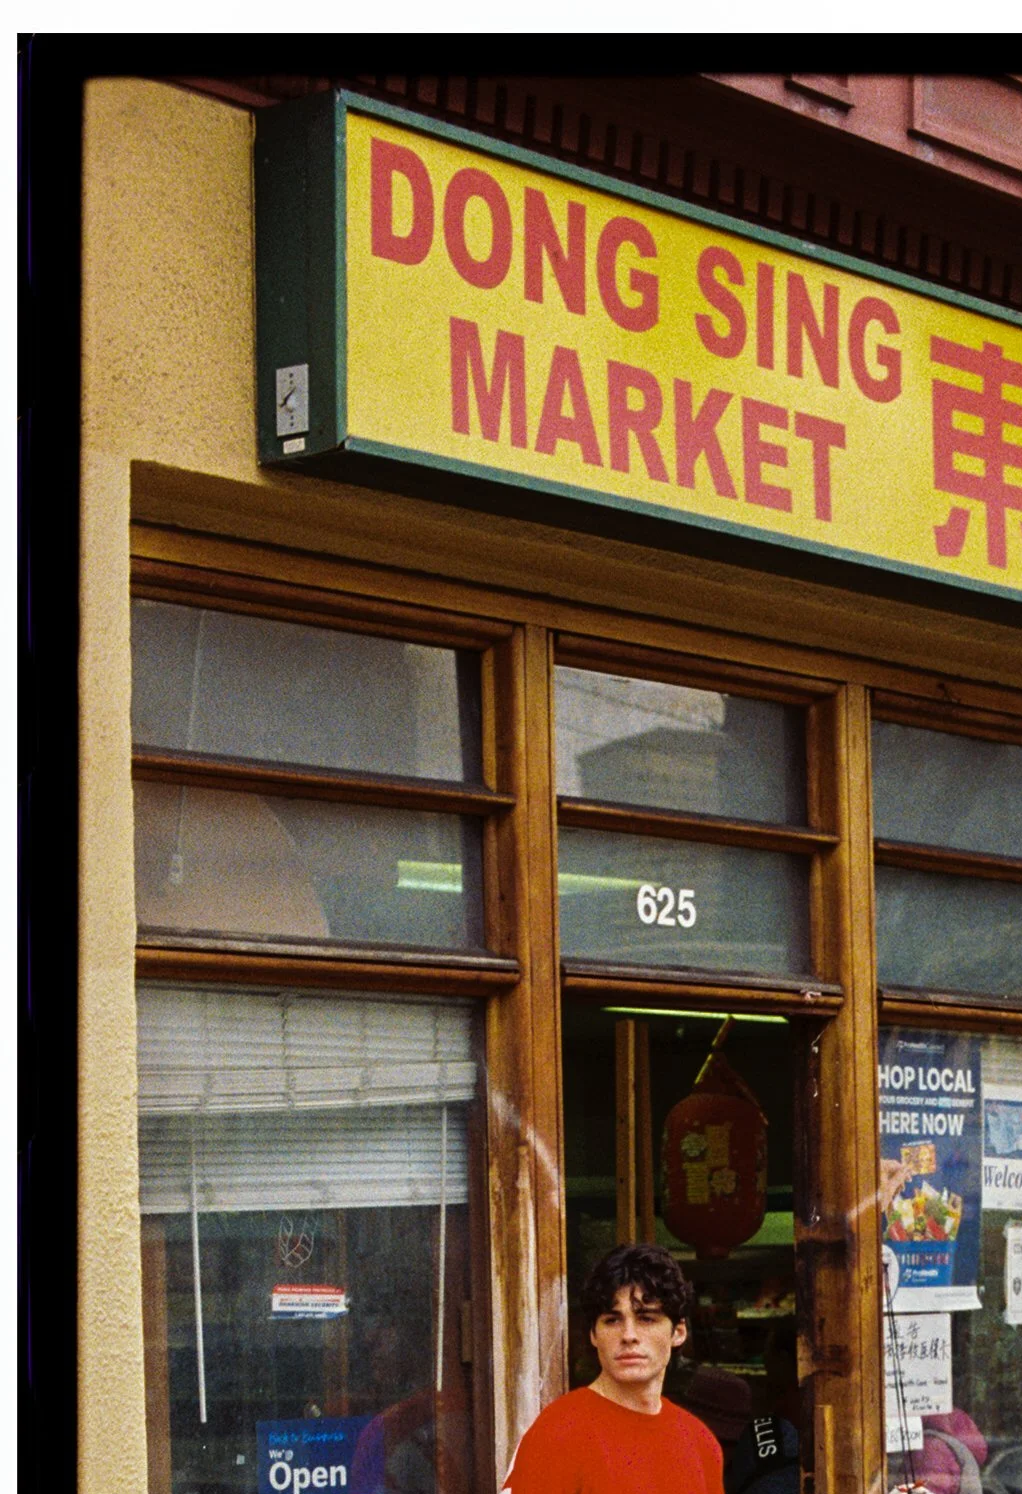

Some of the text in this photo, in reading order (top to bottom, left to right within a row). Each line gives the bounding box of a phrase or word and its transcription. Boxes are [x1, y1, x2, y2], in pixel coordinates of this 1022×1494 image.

[370, 137, 902, 403] DONG SING
[449, 316, 846, 522] MARKET
[636, 883, 696, 928] 625
[878, 1064, 976, 1093] HOP LOCAL
[879, 1111, 964, 1136] HERE NOW
